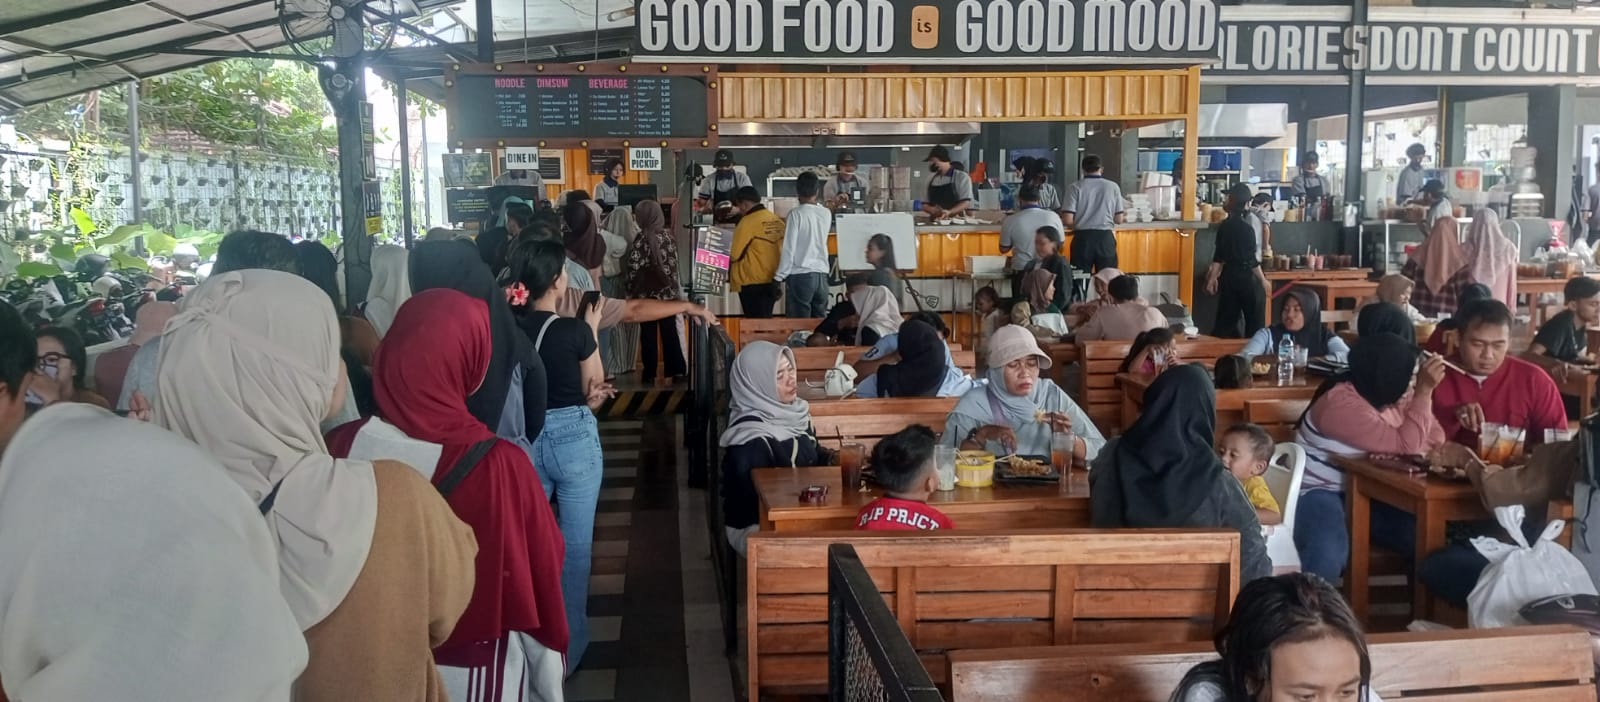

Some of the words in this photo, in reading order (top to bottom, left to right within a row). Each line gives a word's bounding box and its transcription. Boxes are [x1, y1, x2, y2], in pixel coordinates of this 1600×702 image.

[640, 0, 763, 52] GOOD
[773, 0, 894, 53] FOOD
[917, 18, 932, 33] is
[956, 0, 1075, 52] GOOD
[1083, 0, 1216, 51] MOOD
[1202, 25, 1368, 71] LORIES
[1474, 27, 1592, 73] COUNT
[494, 78, 526, 88] NOODLE
[537, 78, 569, 88] DIMSUM
[588, 78, 628, 89] BEVERAGE
[507, 153, 527, 163] DINE
[528, 153, 537, 163] IN
[631, 159, 659, 168] PICKUP
